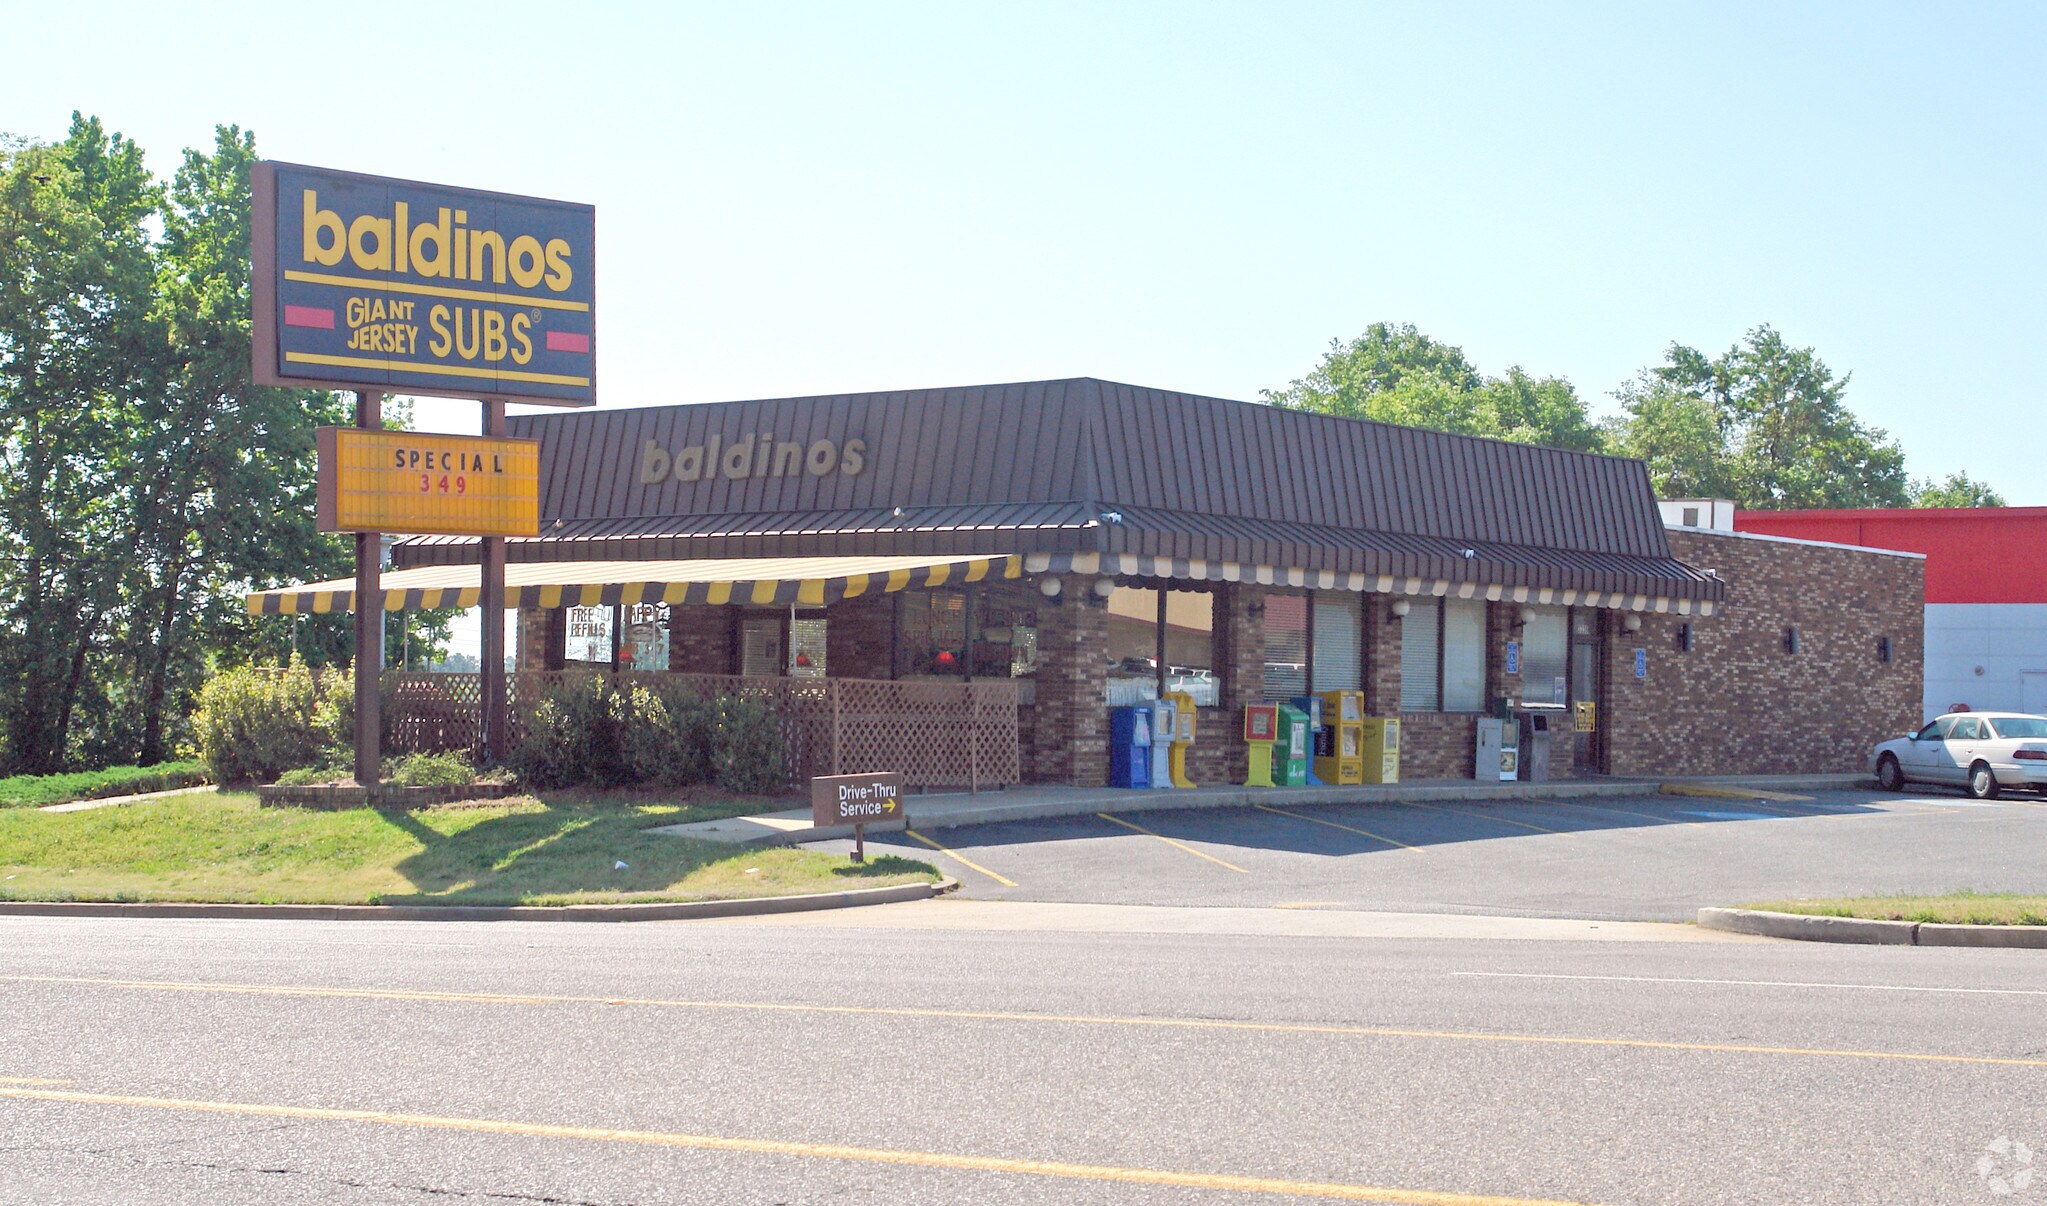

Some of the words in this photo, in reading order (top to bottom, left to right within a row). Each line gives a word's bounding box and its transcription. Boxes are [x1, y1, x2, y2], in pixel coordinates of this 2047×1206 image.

[303, 189, 572, 292] baldinos
[346, 296, 415, 329] GIANT
[346, 327, 418, 354] JERSEY
[395, 449, 503, 473] SPECIAL
[641, 432, 867, 484] baldinos
[420, 474, 467, 495] 349
[571, 608, 594, 622] FREE
[838, 783, 897, 801] Drive-Thru
[839, 800, 882, 817] Service
